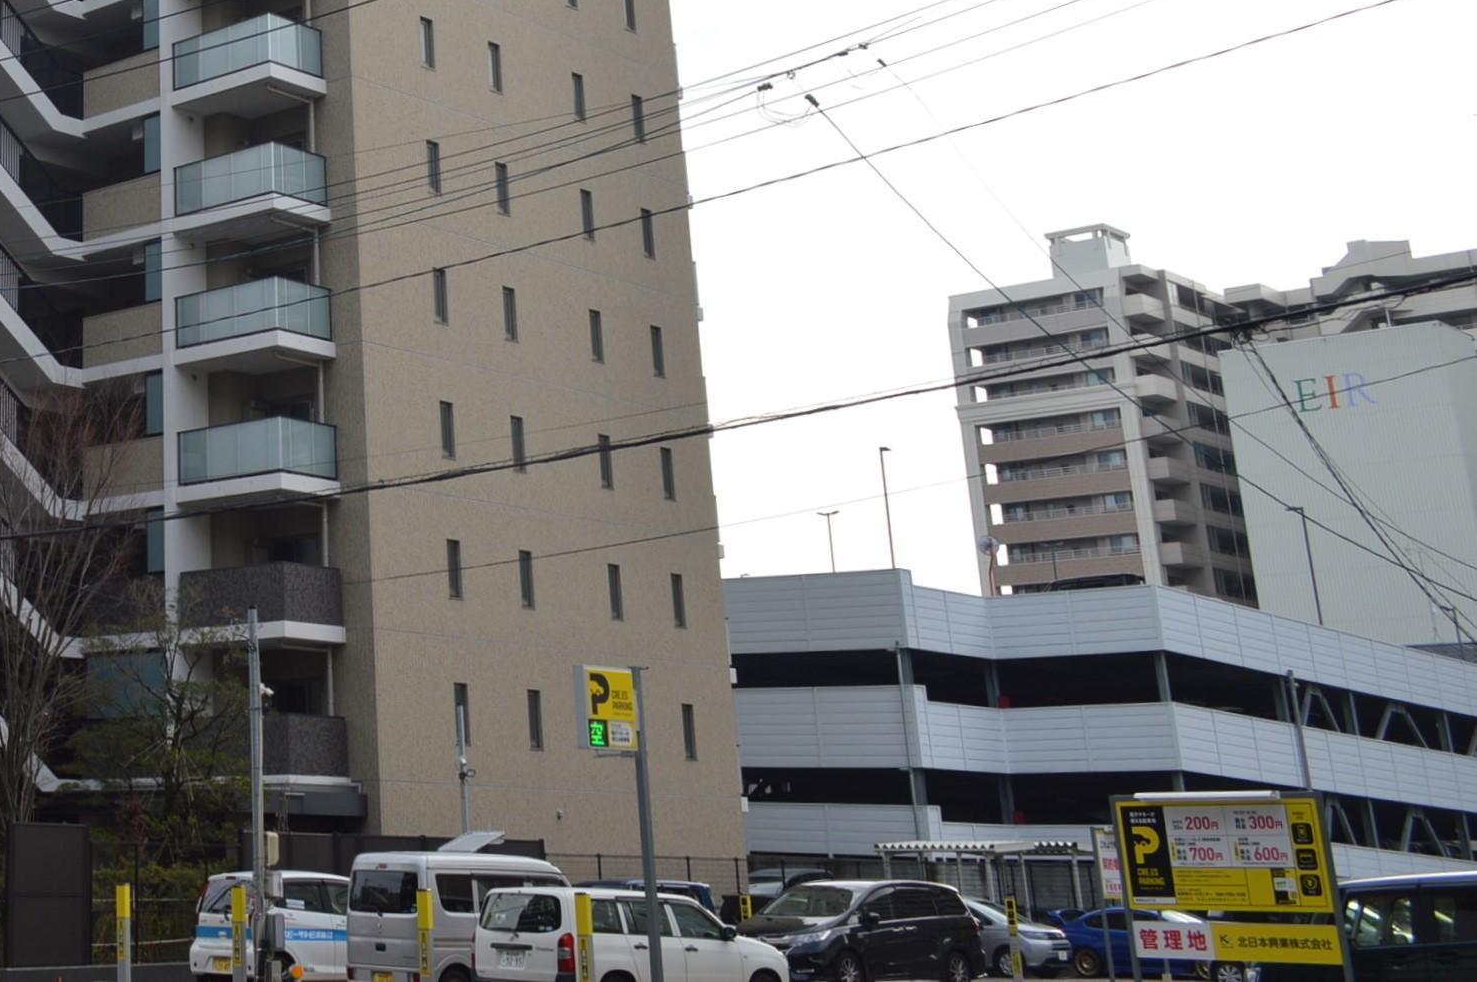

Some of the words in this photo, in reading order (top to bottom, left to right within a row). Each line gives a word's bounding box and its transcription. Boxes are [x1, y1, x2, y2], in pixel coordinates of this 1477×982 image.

[1293, 371, 1380, 413] EIR
[1184, 815, 1220, 831] 200円
[1248, 815, 1284, 830] 300円
[1188, 847, 1224, 861] 700円
[1253, 847, 1289, 861] 600円
[1139, 928, 1208, 952] 管理地
